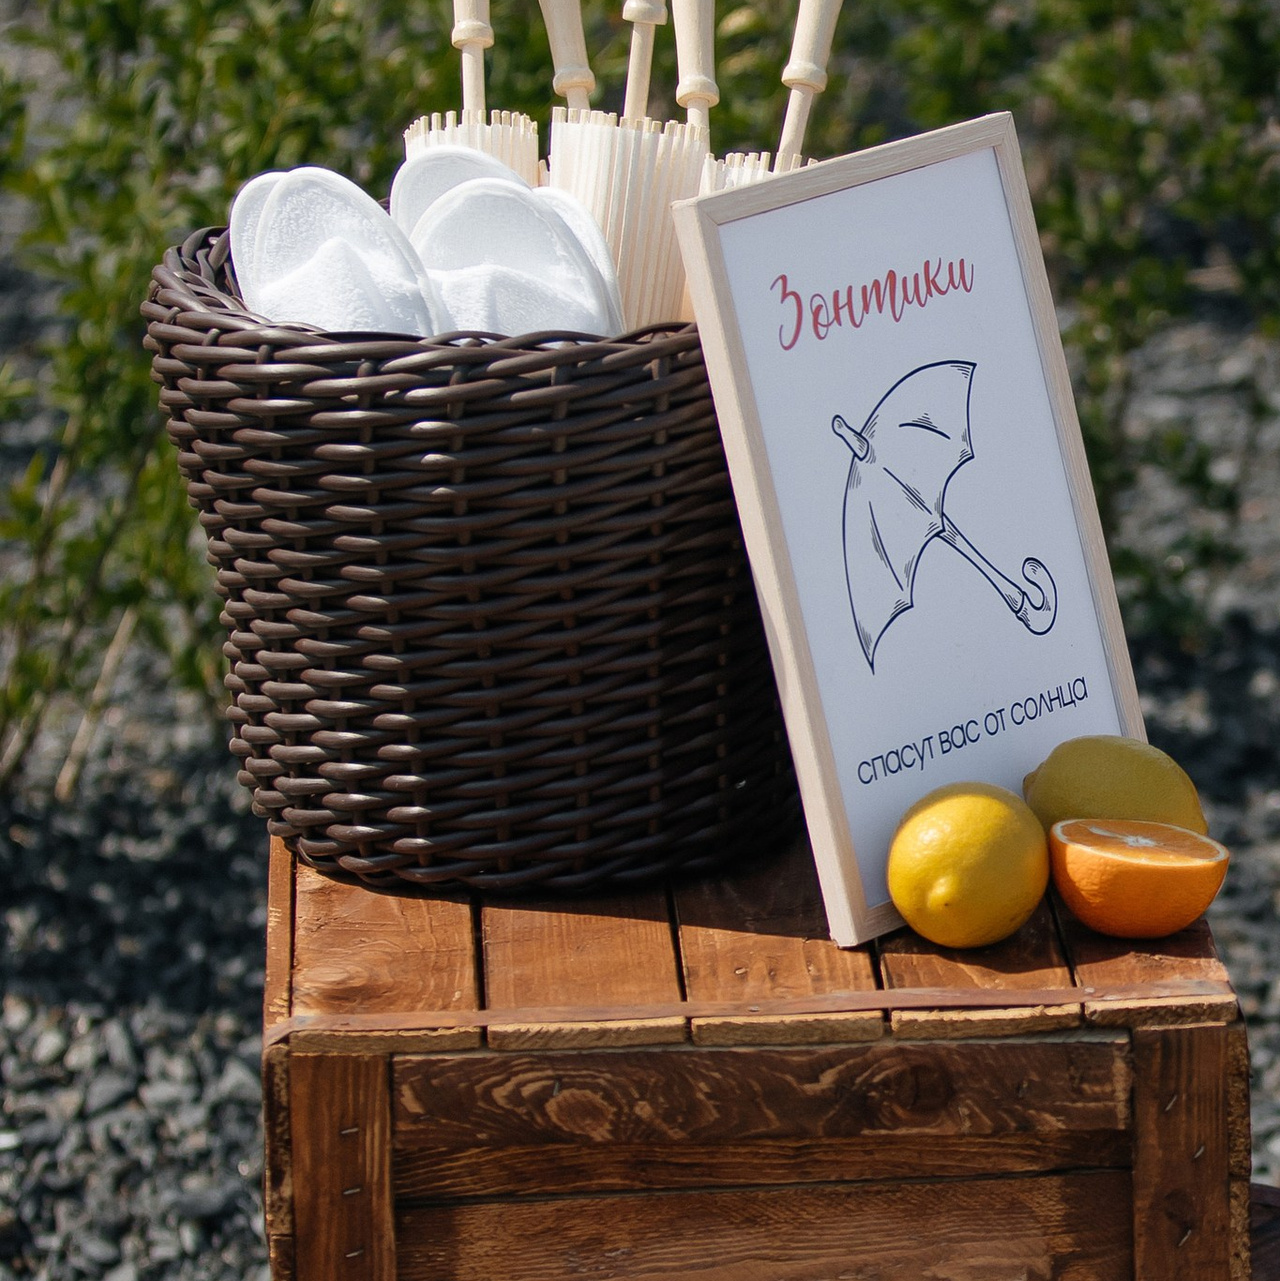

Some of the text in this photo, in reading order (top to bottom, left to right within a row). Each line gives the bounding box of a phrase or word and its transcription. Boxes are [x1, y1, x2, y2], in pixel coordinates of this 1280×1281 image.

[769, 256, 975, 351] Зонтики
[857, 676, 1089, 784] спасут вас от солнца
